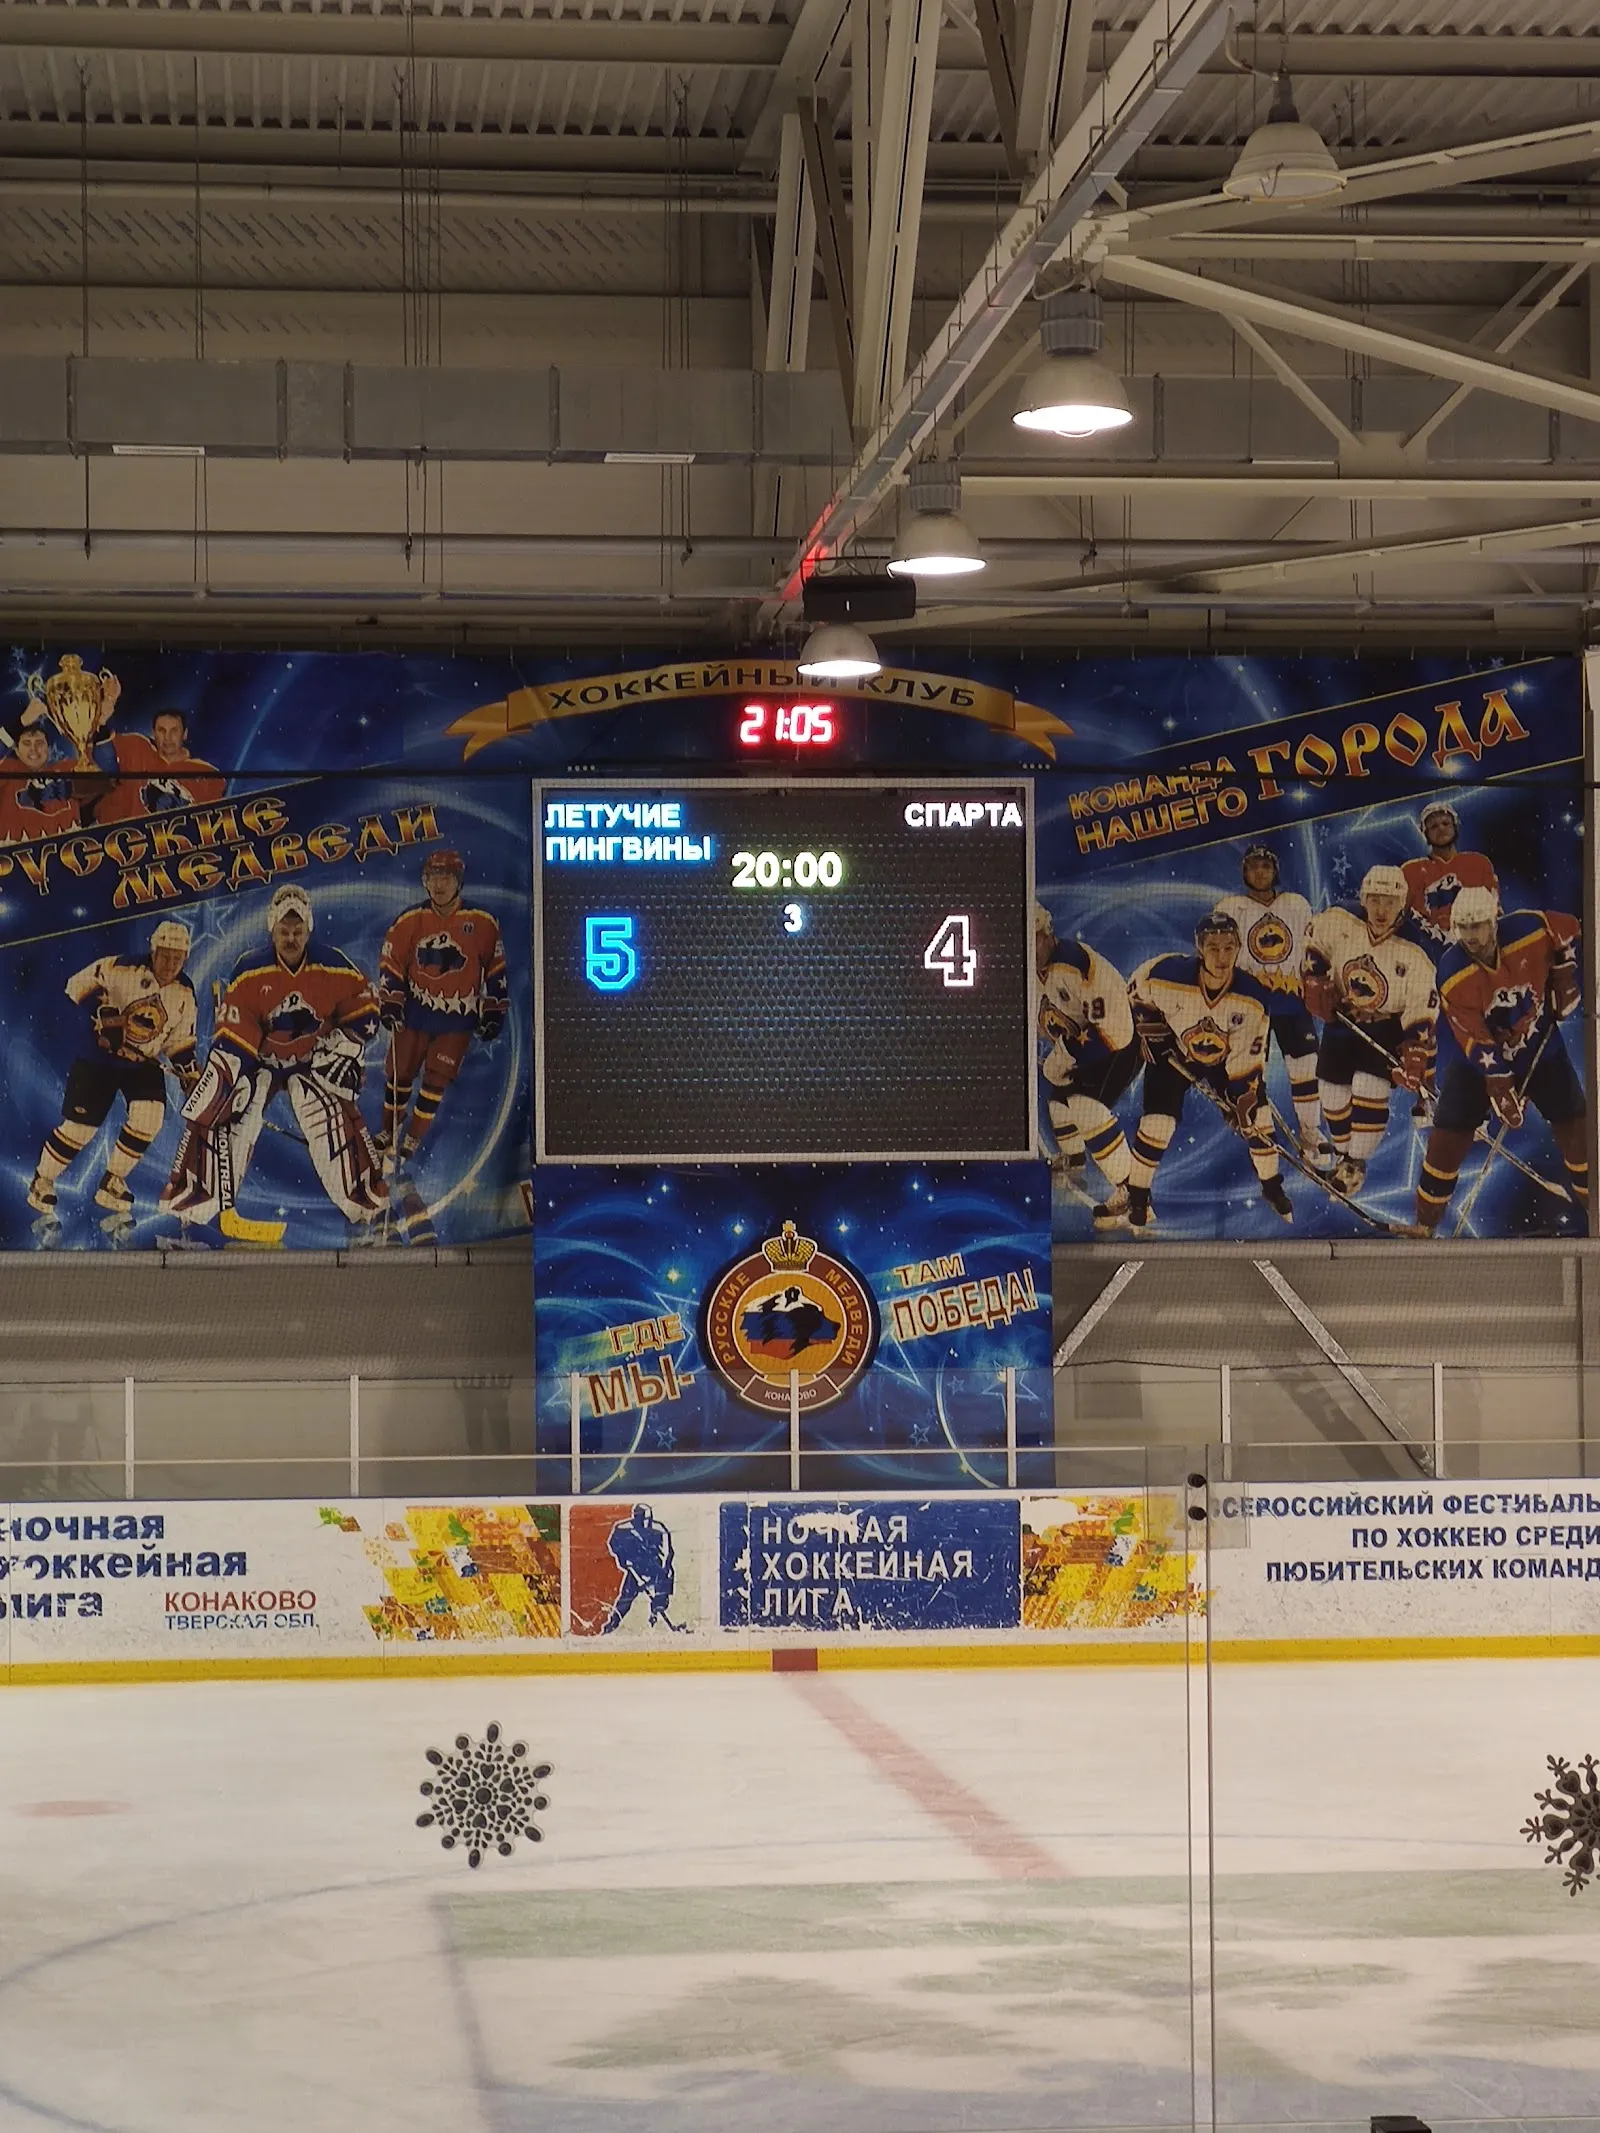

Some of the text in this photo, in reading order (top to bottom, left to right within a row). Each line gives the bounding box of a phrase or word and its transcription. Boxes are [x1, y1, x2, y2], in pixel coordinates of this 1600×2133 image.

[857, 675, 976, 708] КЛУБ
[739, 705, 834, 744] 21:05
[1247, 688, 1531, 801] ГОРОДА
[545, 803, 682, 829] ЛЕТУЧИЕ
[903, 802, 1023, 828] СПАРТА
[1075, 786, 1248, 855] НАШЕГО
[112, 803, 446, 909] МЕДВЕДИ
[545, 836, 712, 862] ПИНГВИНЫ
[731, 850, 844, 888] 20:00
[783, 903, 803, 933] 3
[585, 915, 636, 990] 5
[924, 914, 978, 987] 4
[185, 1069, 214, 1112] VAUGHN
[172, 1128, 192, 1173] VAUGHN
[217, 1126, 233, 1211] MONTREAL
[894, 1253, 967, 1289] ТАМ
[715, 1271, 750, 1363] РУССКИЕ
[825, 1268, 864, 1366] МЕДВЕДИ
[892, 1267, 1039, 1343] ПОБЕДА!
[608, 1313, 686, 1355] ГДЕ
[764, 1388, 817, 1402] КОНАОВО
[1351, 1524, 1600, 1550] ПО ХОККЕЮ СРЕДИ
[761, 1544, 974, 1581] ХОККЕЙНАЯ
[1265, 1556, 1600, 1583] ЛЮБИТЕЛЬСКИХ КОМАНД
[164, 1589, 317, 1612] КОНАКОВО
[761, 1587, 855, 1617] ЛИГА
[164, 1613, 268, 1630] ТВЕРСКАЯ
